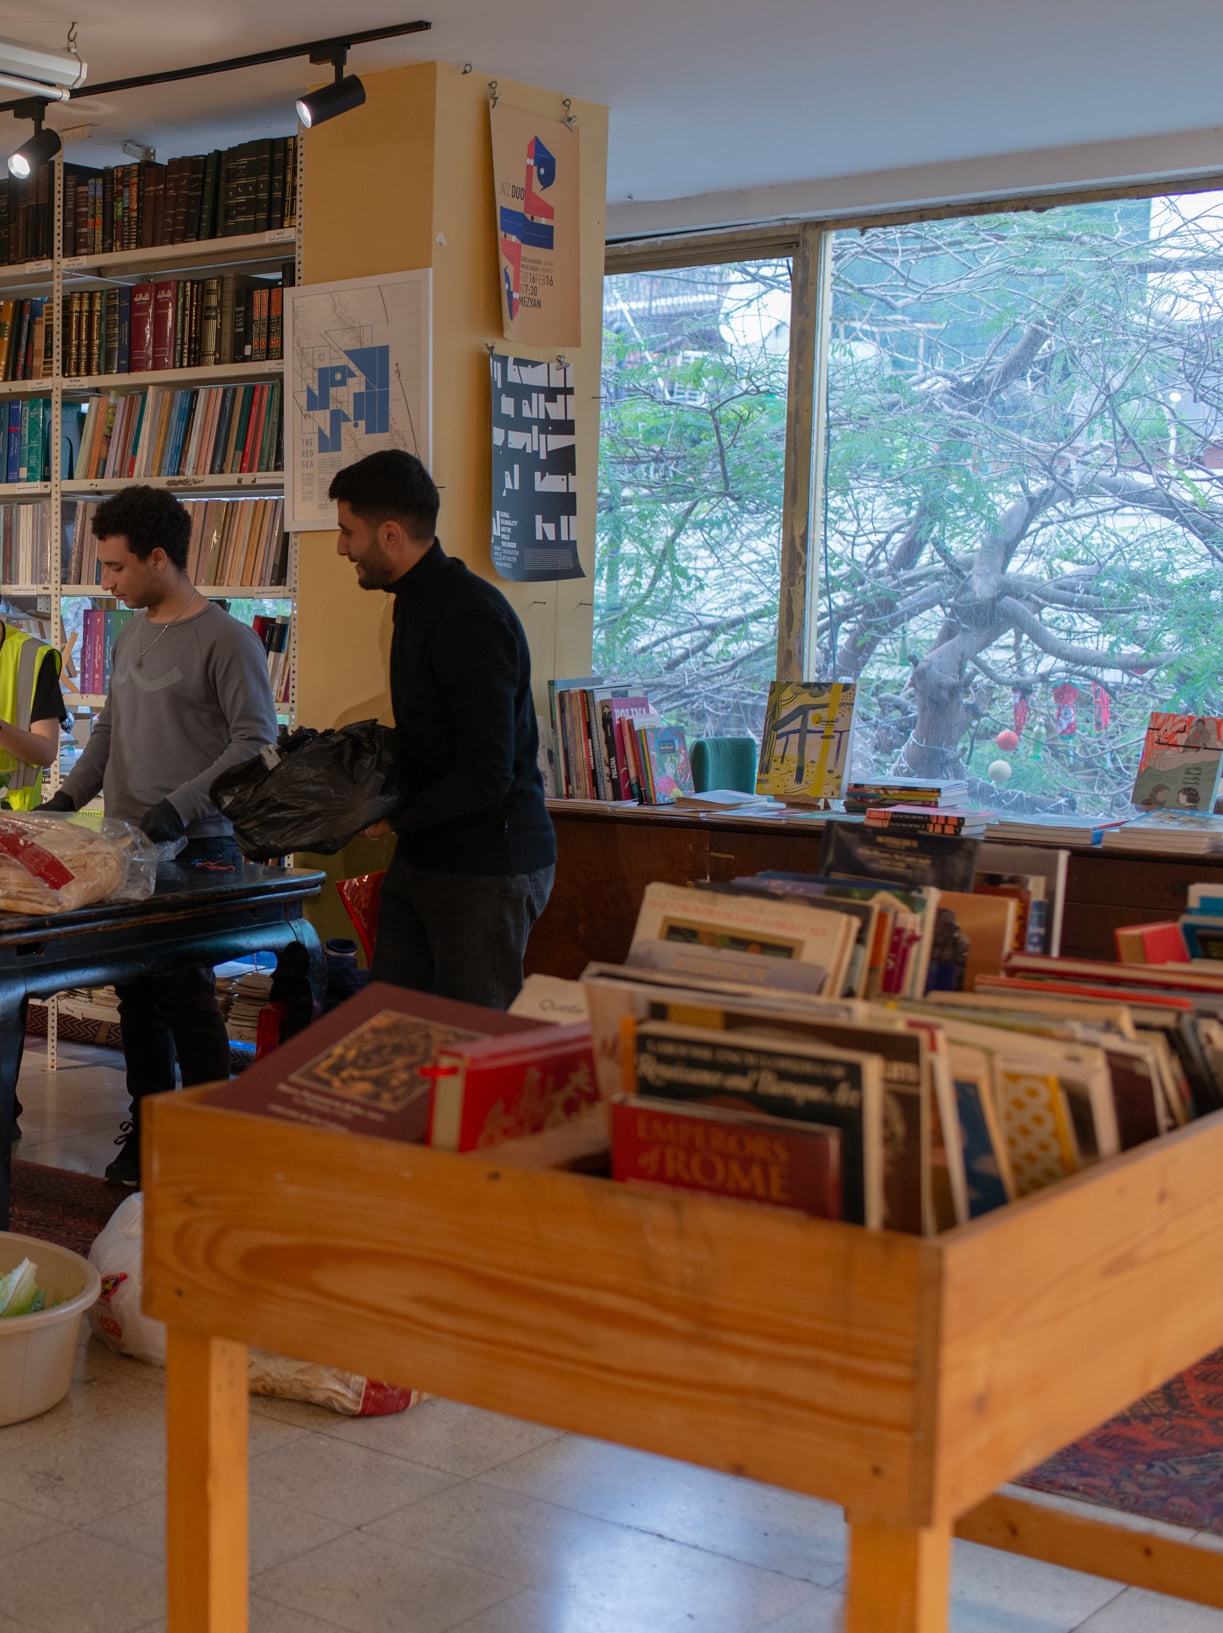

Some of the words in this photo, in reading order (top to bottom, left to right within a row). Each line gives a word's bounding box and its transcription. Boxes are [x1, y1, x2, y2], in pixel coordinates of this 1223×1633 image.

[511, 184, 525, 201] DUO
[520, 296, 542, 309] MEZYAN
[302, 438, 313, 447] THE
[301, 449, 314, 458] RED
[301, 461, 314, 469] SEA
[614, 708, 647, 718] POLINA
[637, 1052, 724, 1087] Renaissance
[726, 1068, 757, 1091] and
[755, 1070, 828, 1106] Baroque
[636, 1113, 789, 1163] EMPERORS
[637, 1144, 662, 1174] of
[664, 1146, 789, 1200] ROME
